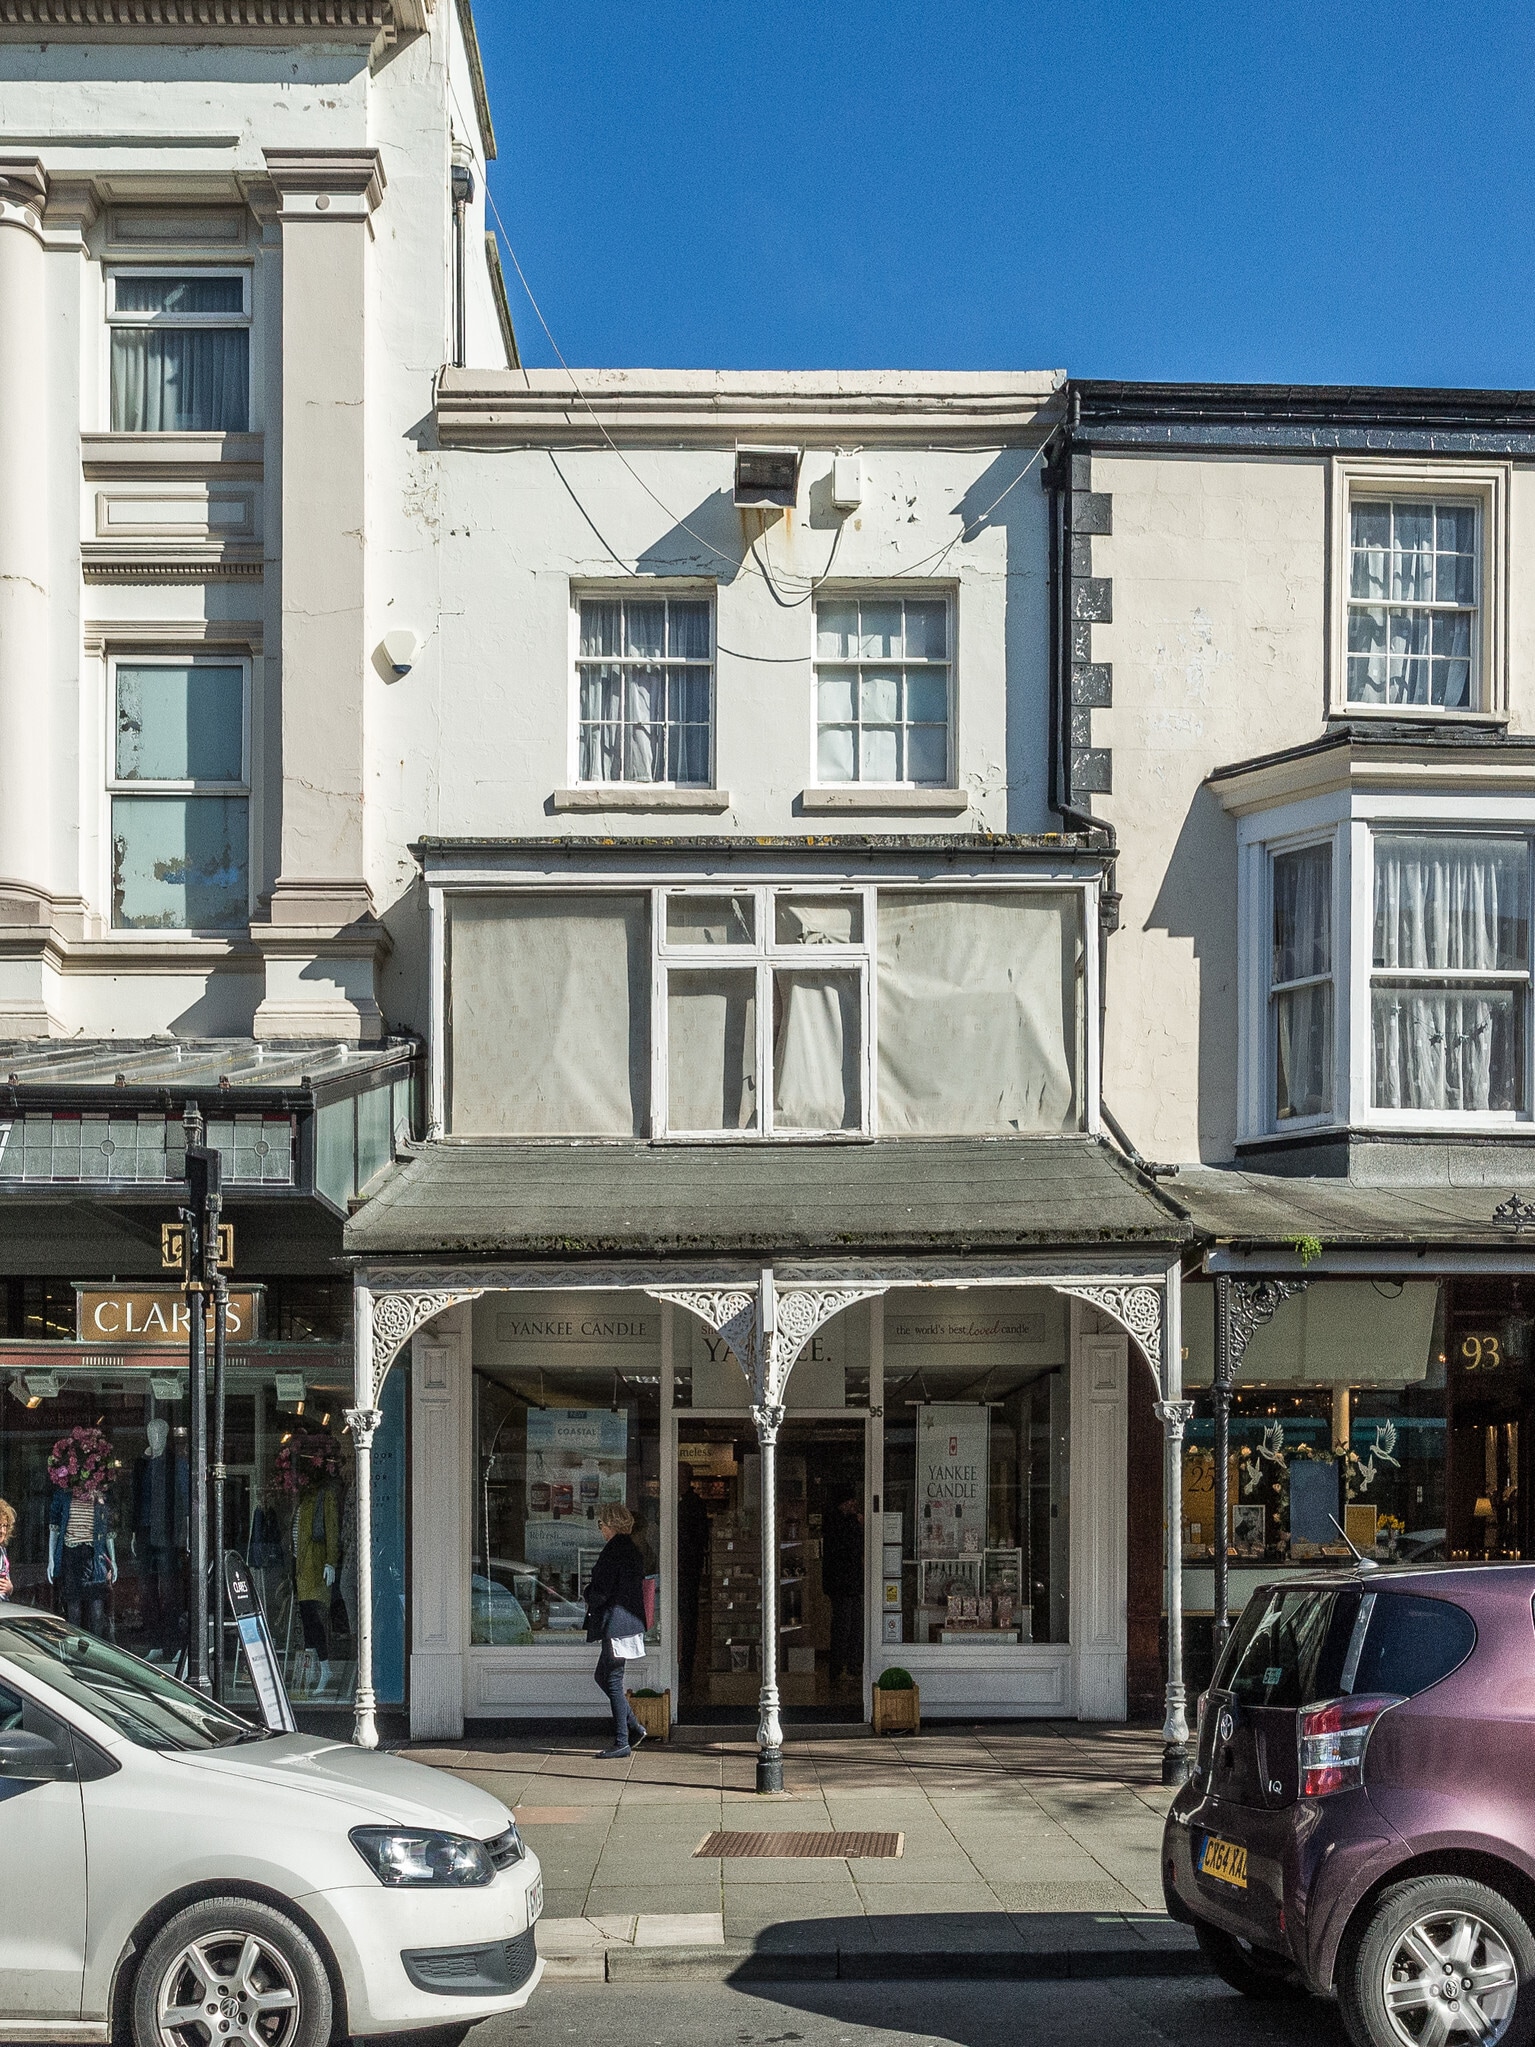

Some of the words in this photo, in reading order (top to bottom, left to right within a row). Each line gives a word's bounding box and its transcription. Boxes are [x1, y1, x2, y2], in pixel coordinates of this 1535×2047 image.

[511, 1322, 573, 1335] YANKEE
[581, 1322, 646, 1336] CANDLE
[896, 1325, 911, 1335] the
[915, 1325, 945, 1334] world's
[949, 1325, 966, 1334] best
[968, 1320, 1001, 1336] loved
[1001, 1324, 1029, 1334] candle
[1462, 1336, 1500, 1370] 93
[870, 1406, 883, 1418] 95
[557, 1428, 597, 1436] COASTAL
[679, 1448, 712, 1457] meless
[928, 1465, 977, 1480] YANKEE
[927, 1483, 977, 1498] CANDLE
[1268, 1780, 1282, 1795] IQ
[1204, 1840, 1231, 1873] CX64
